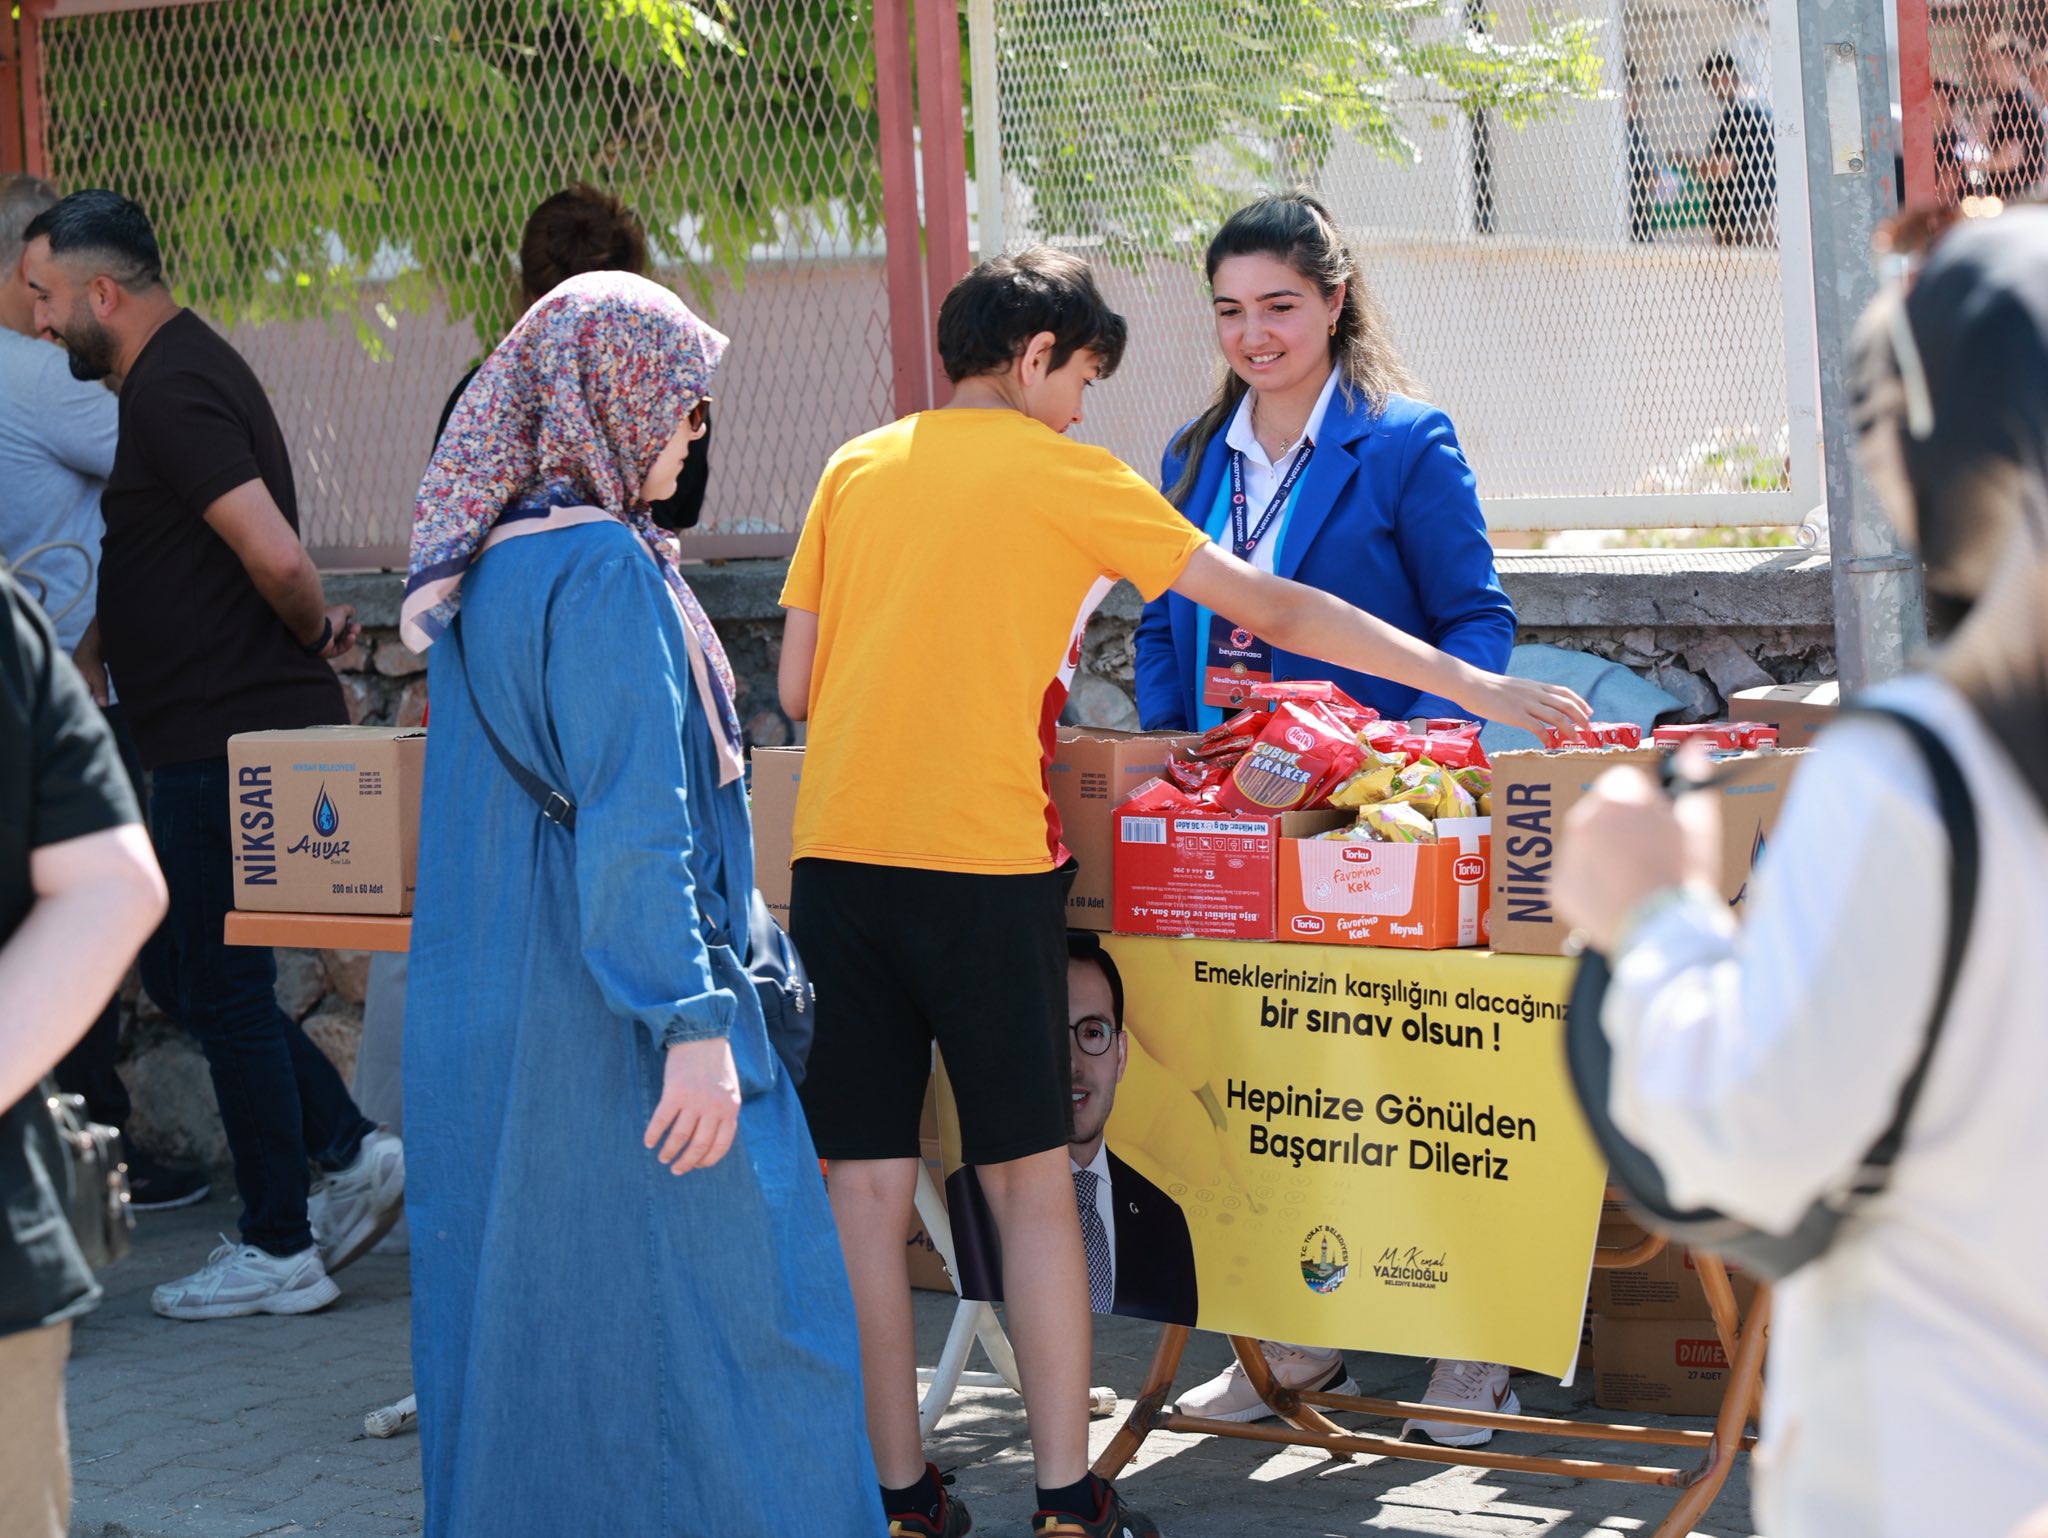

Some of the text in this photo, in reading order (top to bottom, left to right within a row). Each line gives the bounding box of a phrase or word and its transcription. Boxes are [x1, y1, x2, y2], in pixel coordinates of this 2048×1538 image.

[1283, 448, 1311, 488] beyazmasa
[1235, 506, 1243, 542] beyazmasa
[1253, 499, 1280, 539] beyazmasa
[1218, 647, 1262, 659] beyazmasa
[1289, 728, 1310, 748] Halk
[1249, 756, 1312, 783] KRAKER
[235, 765, 277, 886] NİKSAR
[1175, 821, 1191, 830] Adet
[1191, 821, 1200, 830] 36
[1219, 822, 1229, 831] 40
[1254, 823, 1266, 832] Net
[1345, 849, 1369, 860] Torku
[1498, 783, 1553, 923] NİKSAR
[1457, 862, 1481, 876] Torku
[332, 884, 345, 894] 200
[346, 884, 354, 894] ml
[359, 884, 368, 894] 60
[369, 883, 384, 894] Adet
[1347, 880, 1373, 893] Kek
[1076, 896, 1086, 907] 60
[1087, 896, 1104, 909] Adet
[1150, 908, 1169, 918] San.
[1170, 910, 1191, 918] Gıda
[1204, 911, 1237, 921] Bisküvi
[1296, 919, 1320, 930] Torku
[1348, 927, 1371, 940] Kek
[1194, 960, 1337, 995] Emeklerinizin
[1345, 973, 1448, 1011] karşılığını
[1260, 995, 1500, 1052] bir sınav olsun !
[1227, 1078, 1536, 1142] Hepinize Gönülden
[1249, 1123, 1509, 1181] Başarılar Dileriz
[1303, 1225, 1323, 1244] TOKAT
[1373, 1264, 1448, 1283] YAZICIOĞLU
[1680, 1341, 1728, 1364] DİME
[1688, 1370, 1722, 1381] 27 ADET
